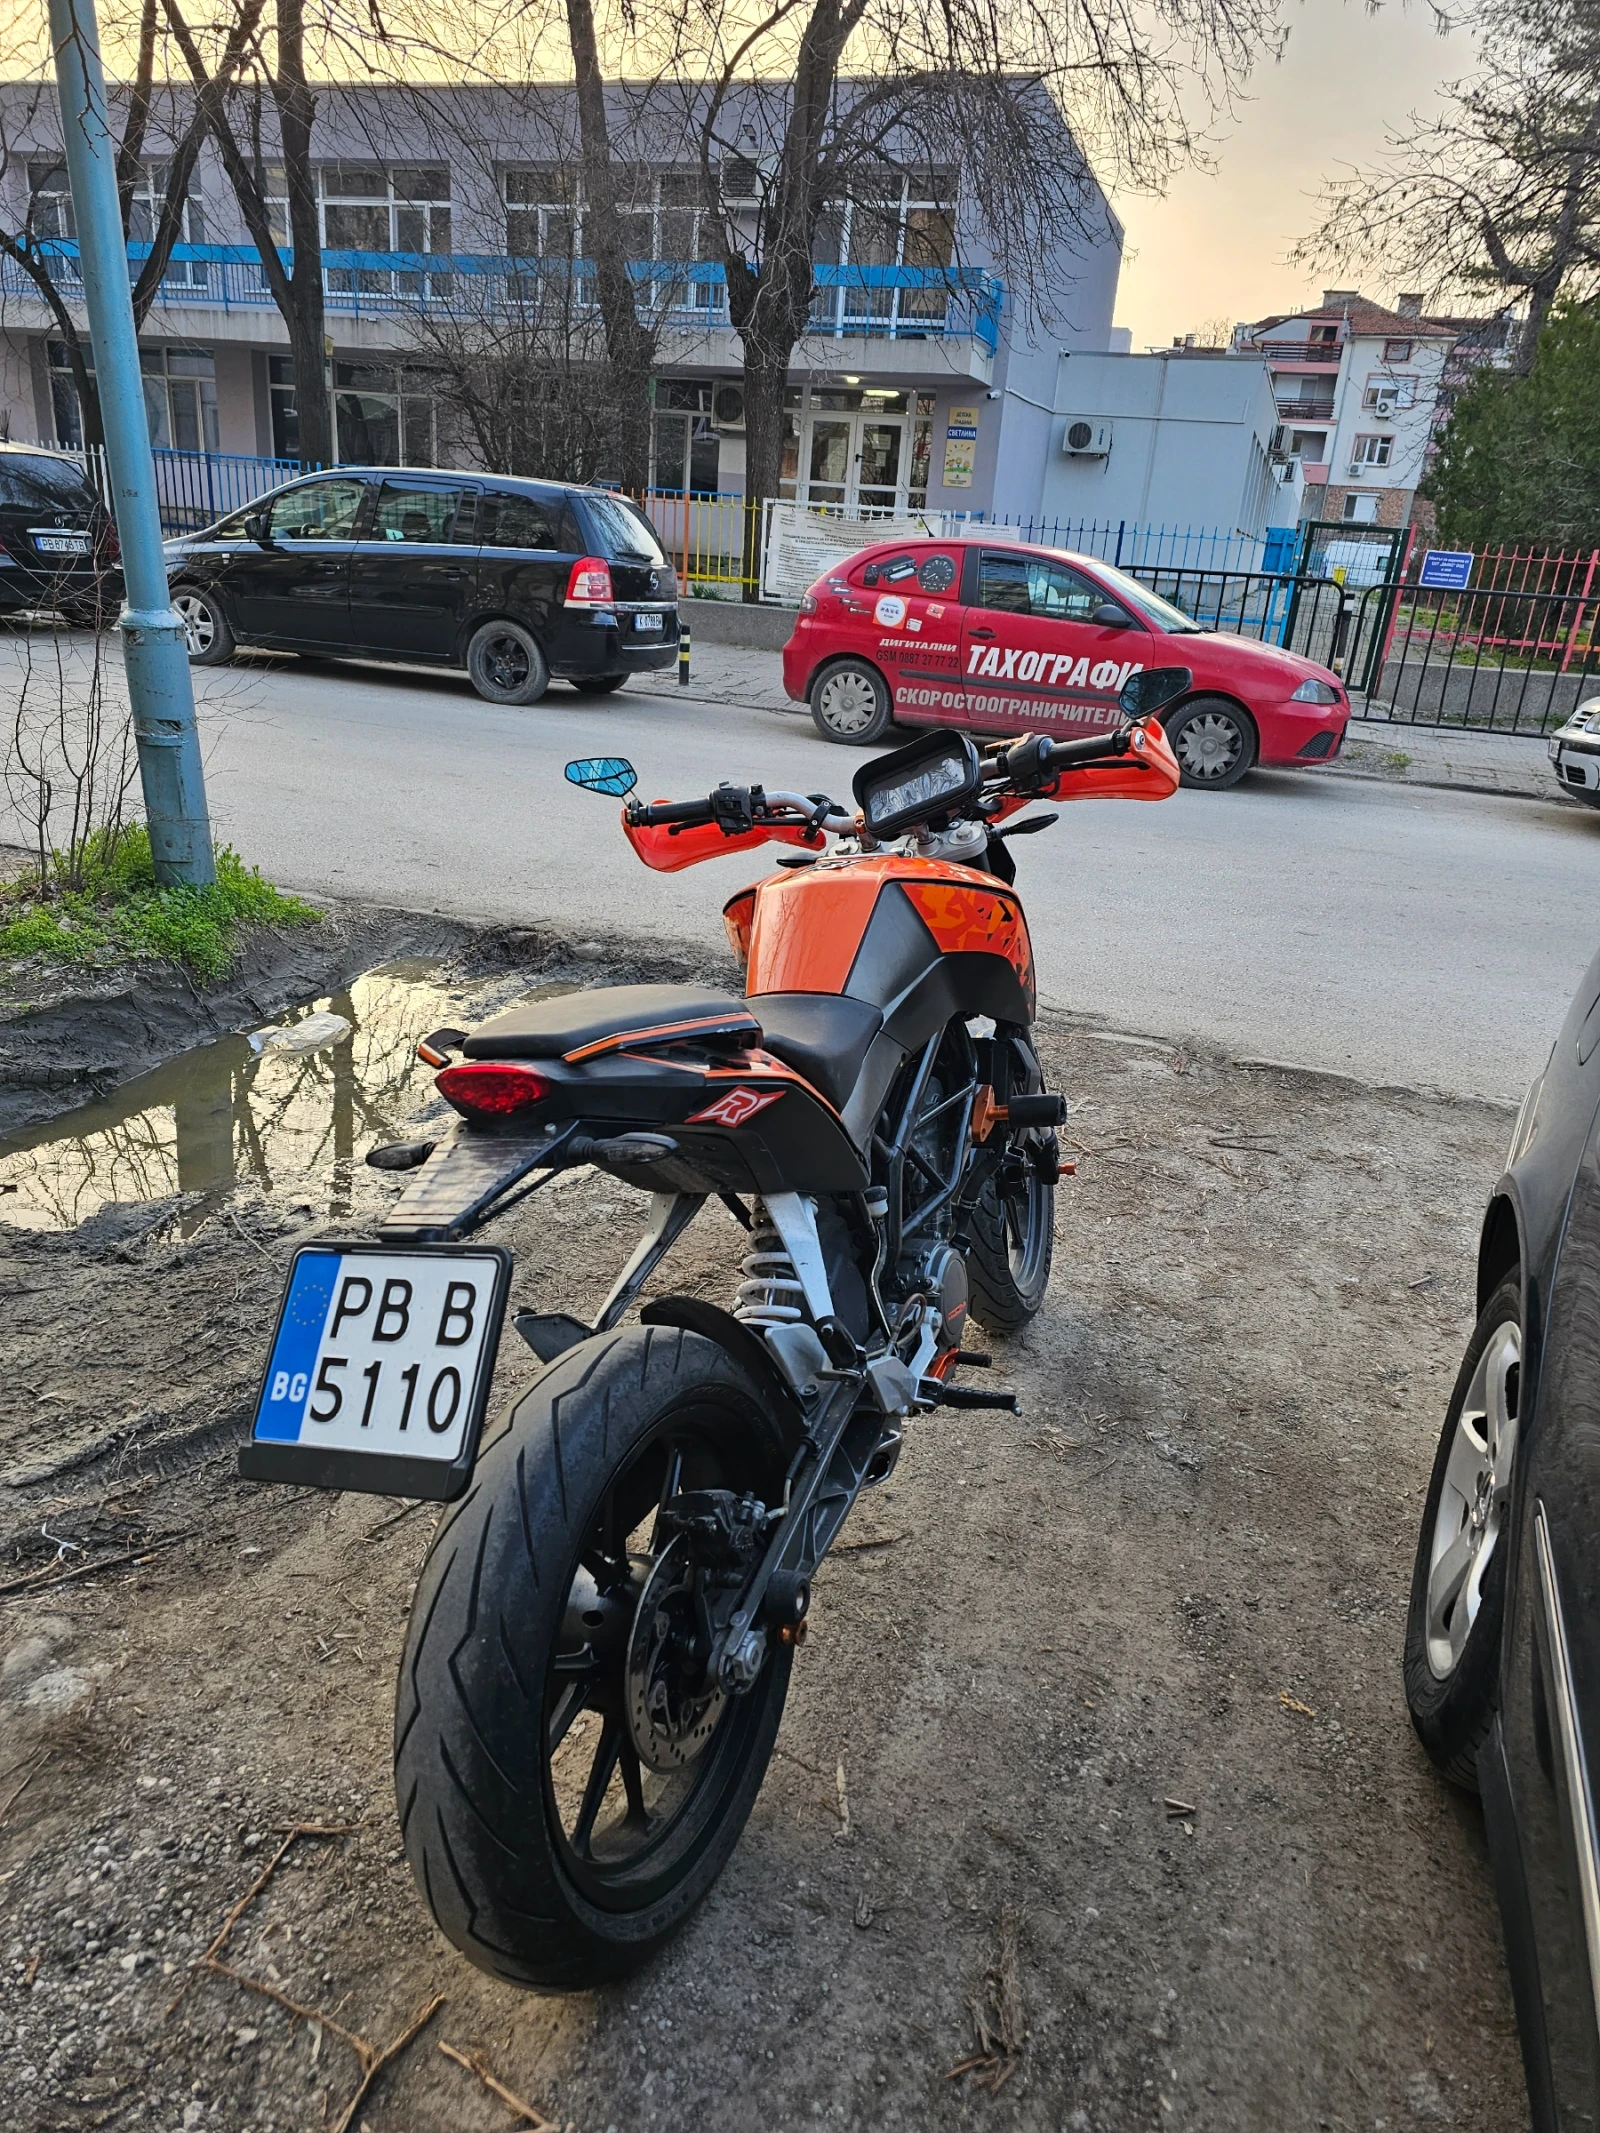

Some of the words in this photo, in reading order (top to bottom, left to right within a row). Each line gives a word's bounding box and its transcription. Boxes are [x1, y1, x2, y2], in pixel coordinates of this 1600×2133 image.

[948, 429, 976, 438] СВЕТЛИНА
[876, 649, 897, 663] GSM
[900, 651, 921, 664] 0887
[922, 654, 933, 666] 27
[935, 656, 946, 667] 77
[947, 656, 959, 669] 22
[879, 638, 958, 652] ДИГИТАЛНИ
[966, 644, 1145, 692] ТАХОГРАФИ
[329, 1276, 413, 1343] PB
[435, 1281, 478, 1347] B
[270, 1370, 309, 1403] BG
[309, 1357, 462, 1434] 5110
